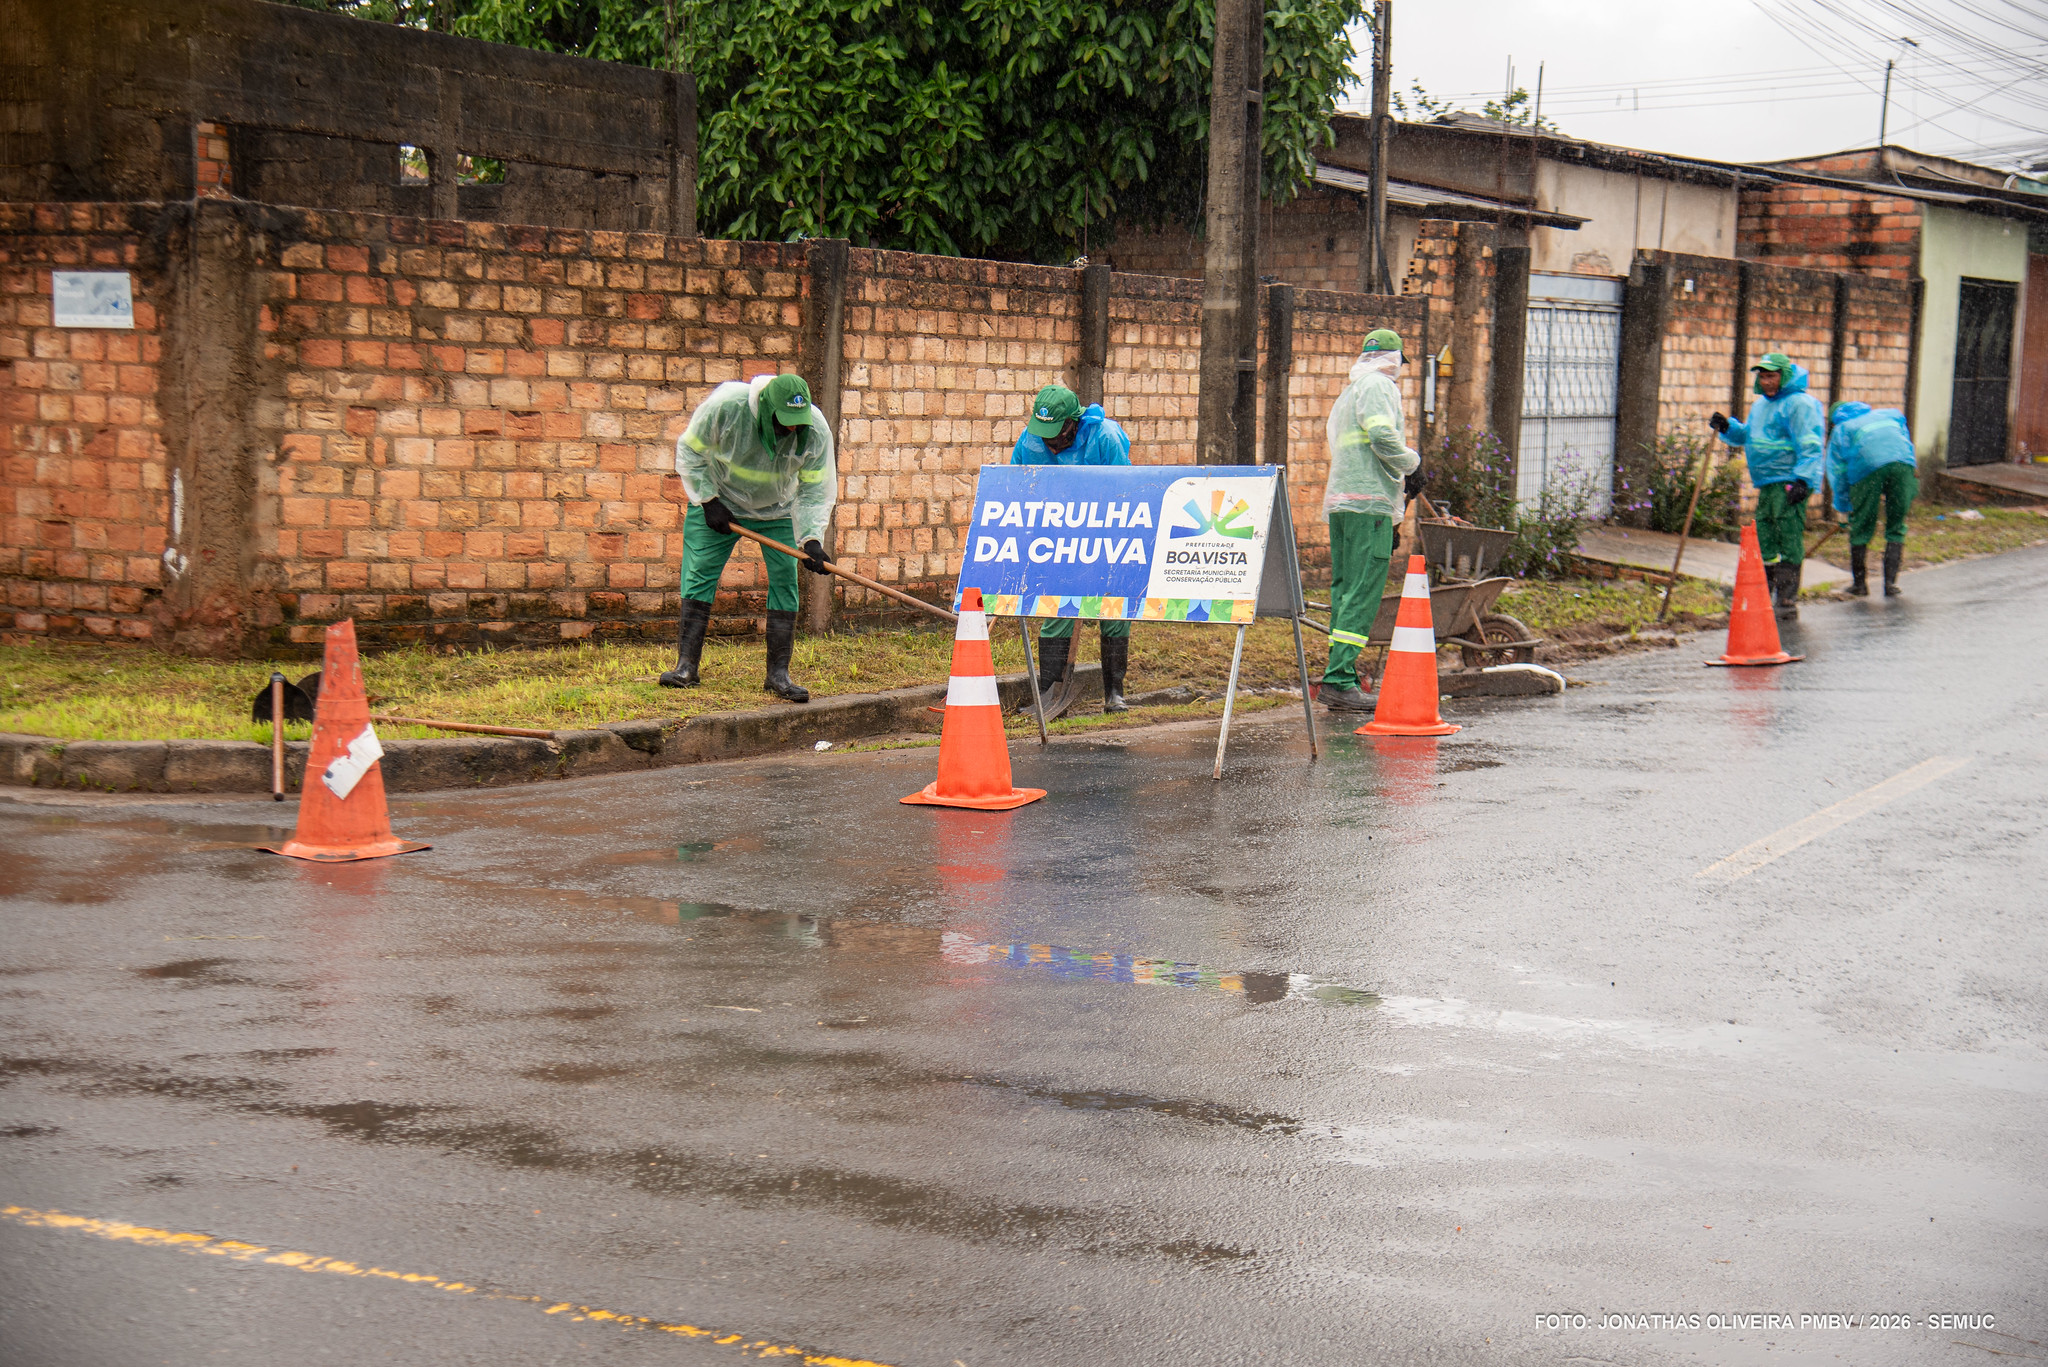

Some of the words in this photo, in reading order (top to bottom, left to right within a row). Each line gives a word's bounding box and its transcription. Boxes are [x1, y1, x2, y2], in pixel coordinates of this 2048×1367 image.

[980, 501, 1153, 528] PATRULHA
[973, 536, 1019, 563] DA
[1028, 537, 1147, 565] CHUVA
[1166, 551, 1201, 564] BOA
[1203, 551, 1248, 565] VISTA
[1166, 575, 1214, 584] CONSERVAÇÃO
